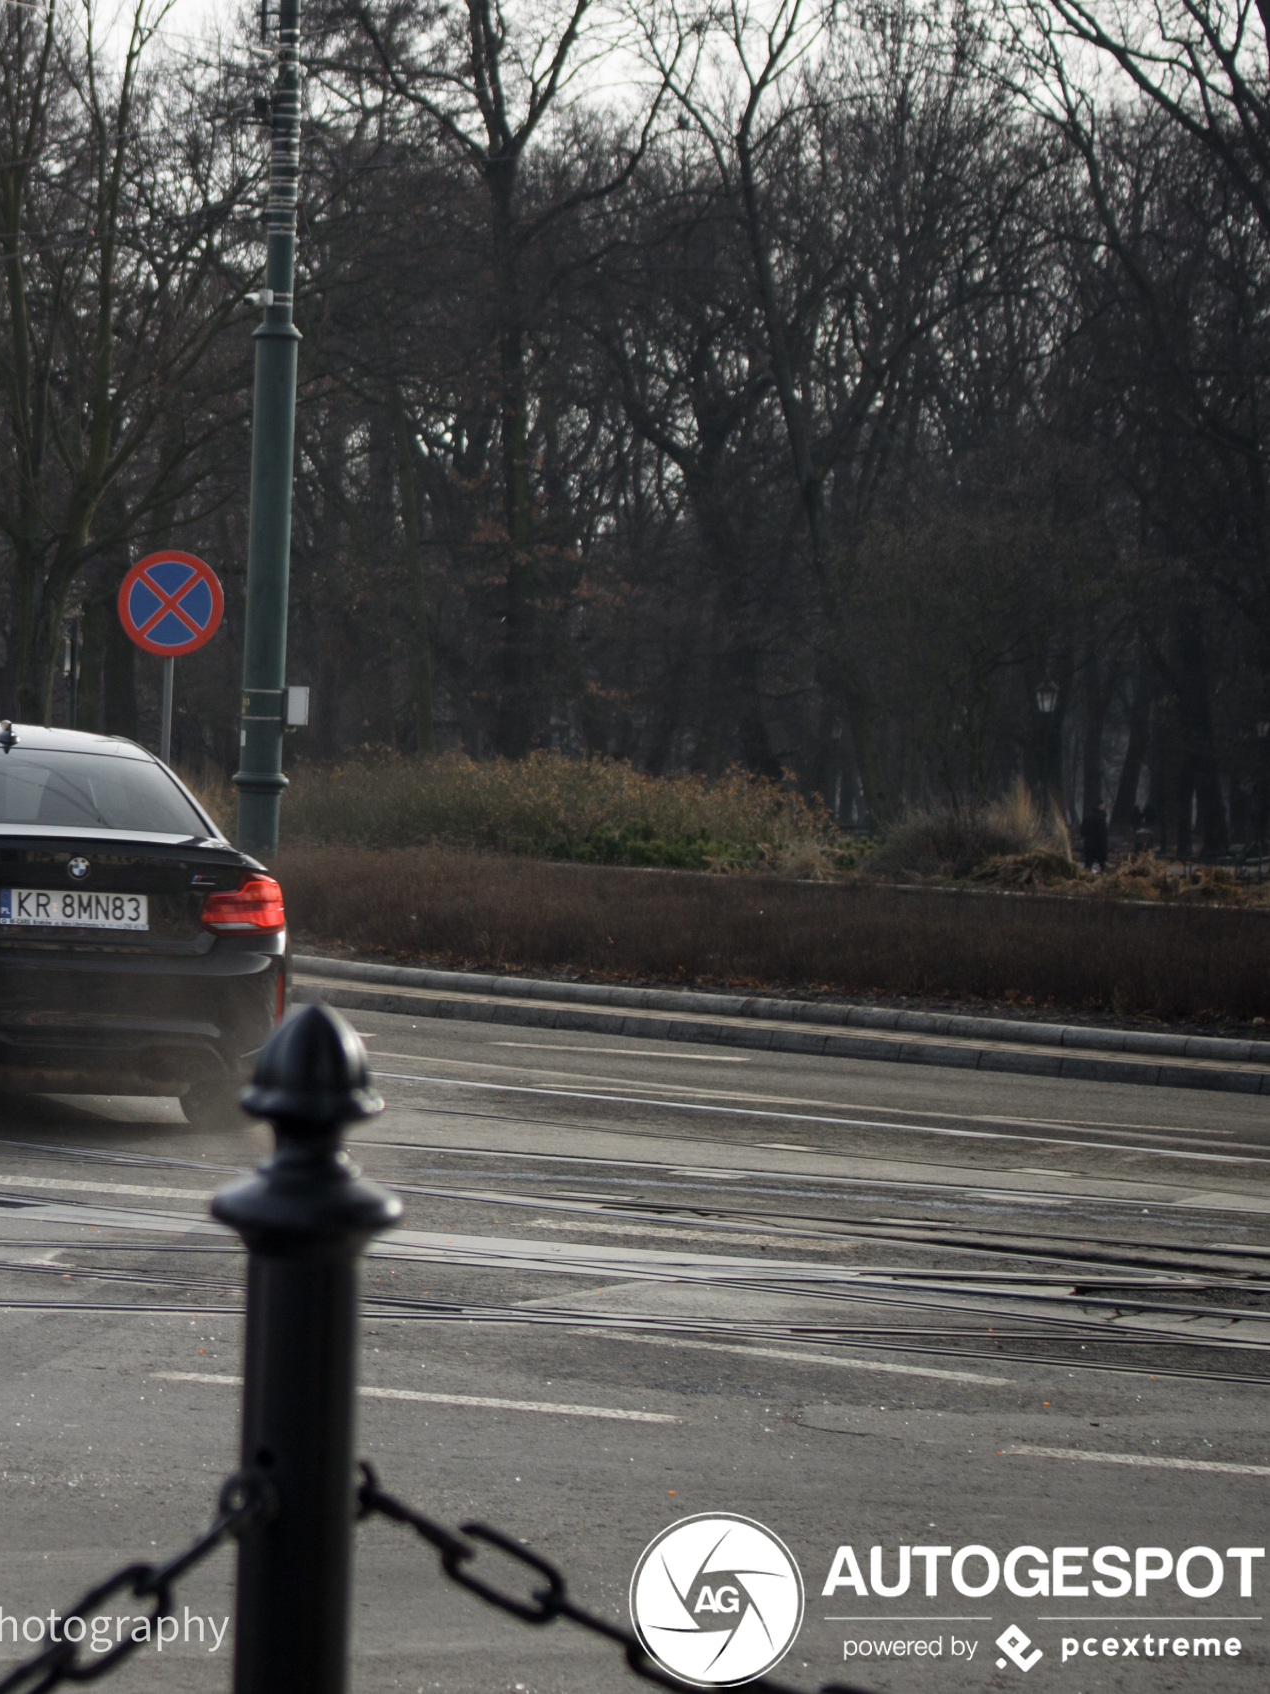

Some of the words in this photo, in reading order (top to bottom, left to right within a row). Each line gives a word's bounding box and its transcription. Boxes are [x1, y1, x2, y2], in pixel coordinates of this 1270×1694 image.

[0, 906, 11, 915] PL
[17, 891, 51, 918] KR
[61, 893, 141, 922] 8MN83
